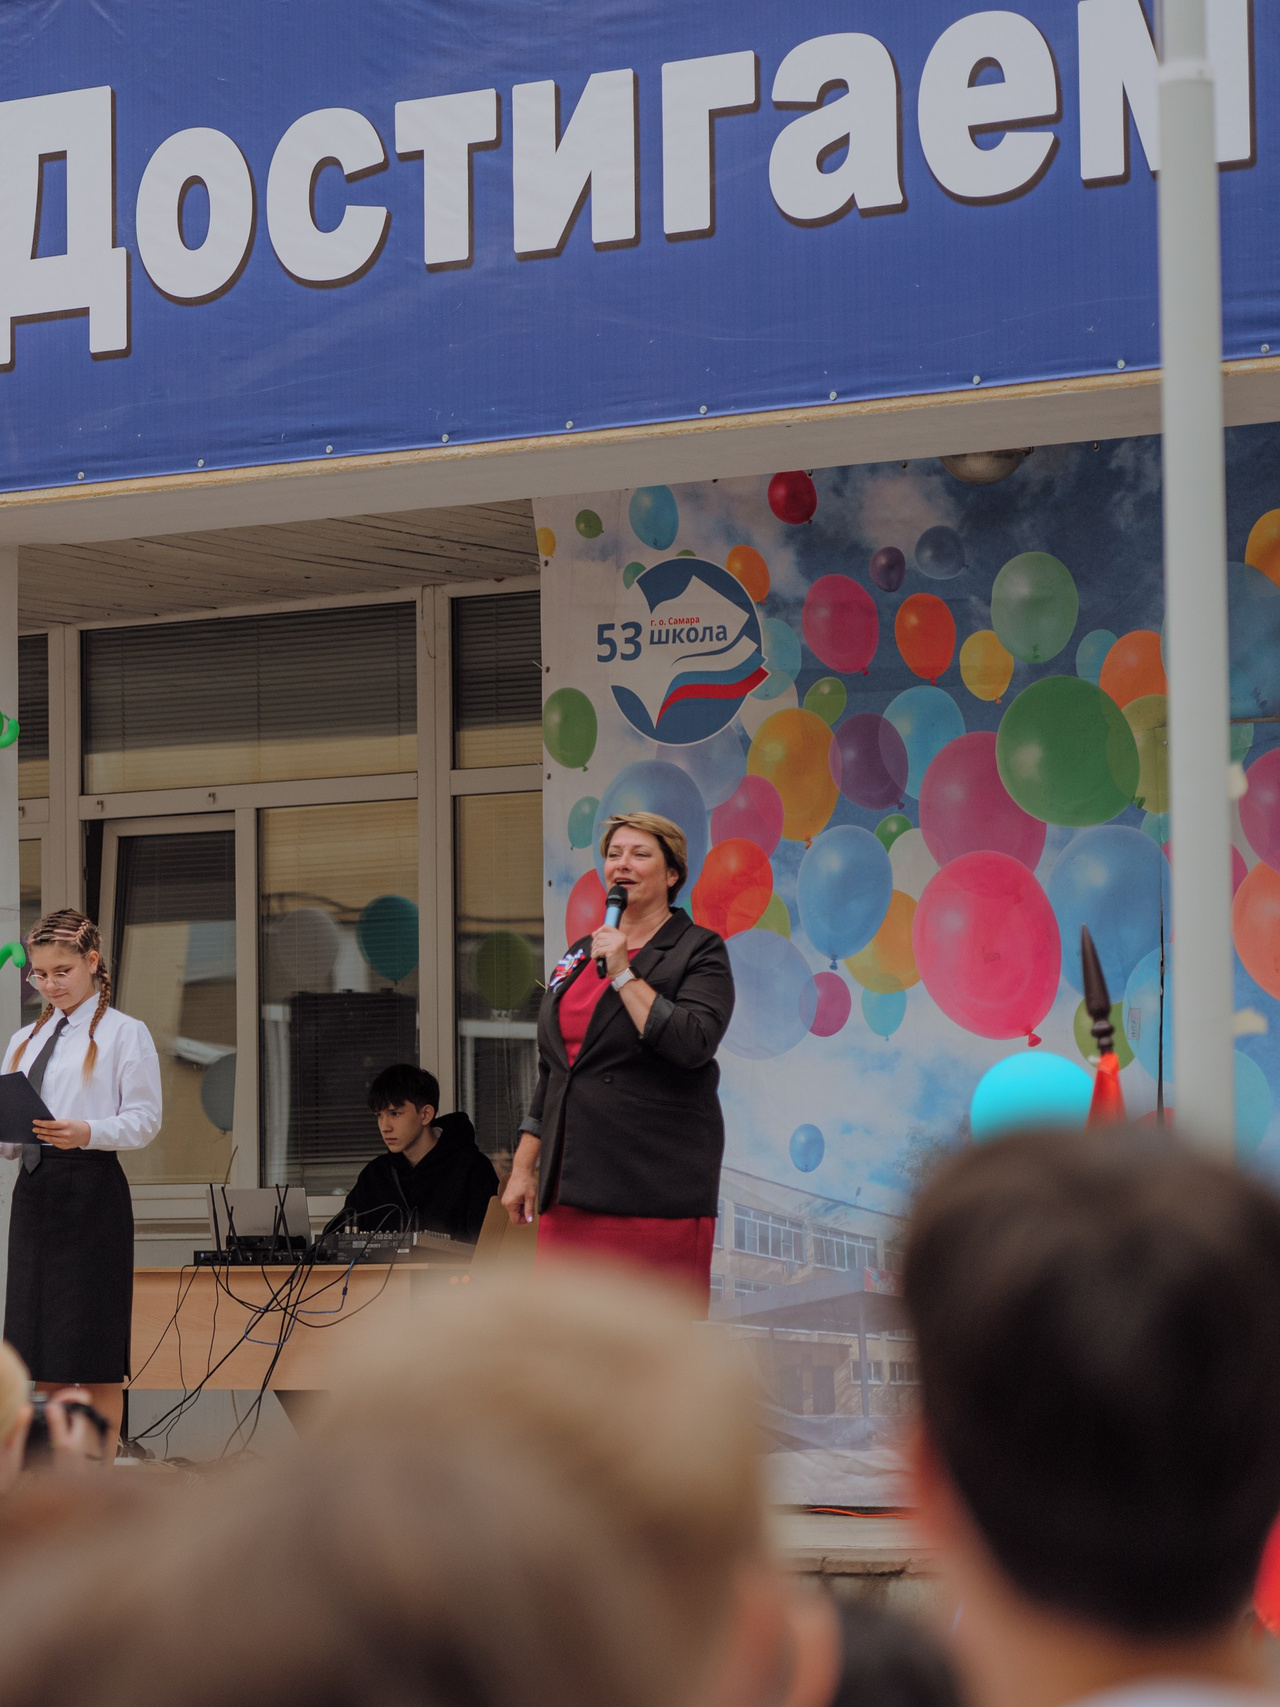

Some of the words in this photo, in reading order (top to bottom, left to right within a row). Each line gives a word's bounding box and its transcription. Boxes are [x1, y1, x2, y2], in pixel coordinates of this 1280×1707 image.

[650, 619, 657, 627] г.
[658, 618, 667, 626] о.
[667, 616, 701, 627] Самара
[596, 621, 643, 663] 53
[649, 624, 728, 645] школа
